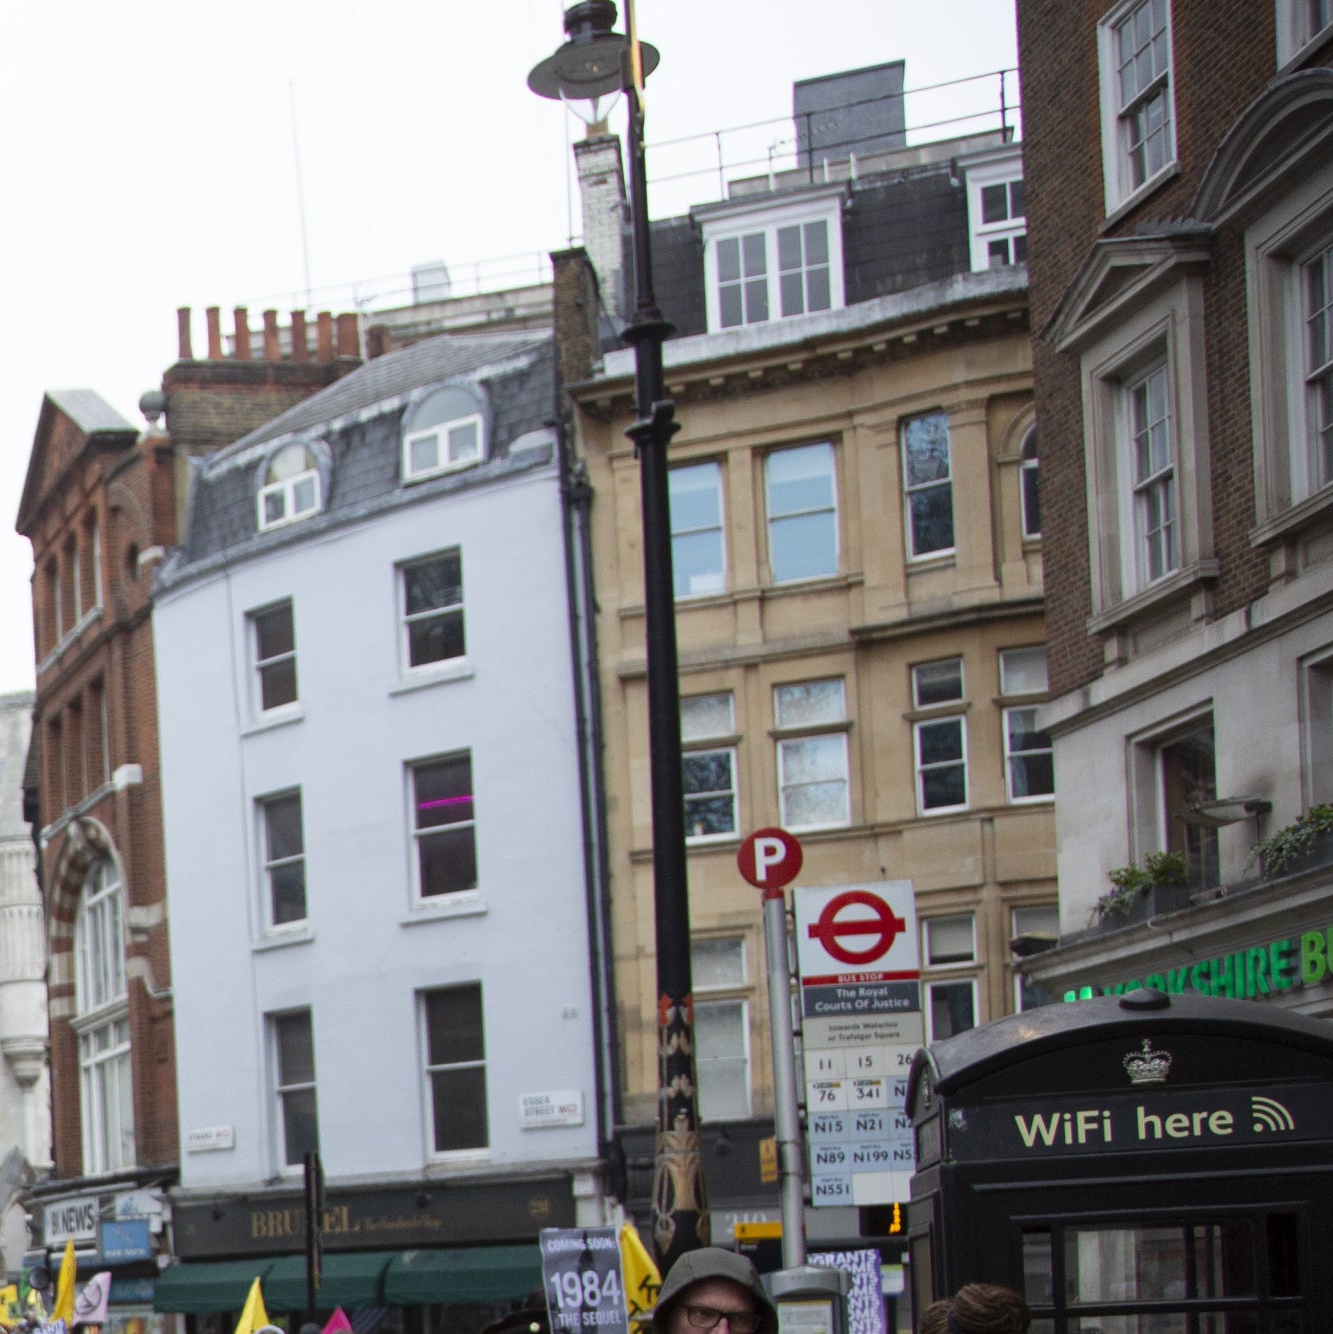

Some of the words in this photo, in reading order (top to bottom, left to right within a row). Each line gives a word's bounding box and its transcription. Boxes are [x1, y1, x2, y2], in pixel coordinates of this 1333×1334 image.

[754, 837, 787, 881] P
[838, 973, 857, 983] BUS
[859, 972, 884, 982] STOP
[836, 988, 856, 998] The
[859, 986, 888, 998] Royal
[815, 1001, 852, 1012] Courts
[855, 999, 869, 1009] Of
[872, 997, 910, 1009] Justice
[819, 1059, 832, 1069] 11
[858, 1056, 873, 1067] 15
[896, 1053, 913, 1065] 26
[819, 1090, 836, 1101] 76
[856, 1087, 880, 1099] 341
[814, 1120, 843, 1133] N15
[856, 1118, 883, 1131] N21
[1014, 1109, 1113, 1148] WiFi
[1136, 1105, 1234, 1141] here
[816, 1151, 845, 1164] N89
[853, 1150, 889, 1162] N199
[815, 1183, 850, 1196] N551
[62, 1203, 95, 1234] NEWS
[250, 1204, 361, 1240] BRUEL
[547, 1239, 586, 1251] COMING
[587, 1237, 616, 1249] SOON:
[550, 1269, 621, 1309] 1984
[558, 1312, 581, 1327] THE
[582, 1310, 622, 1326] SEQUEL
